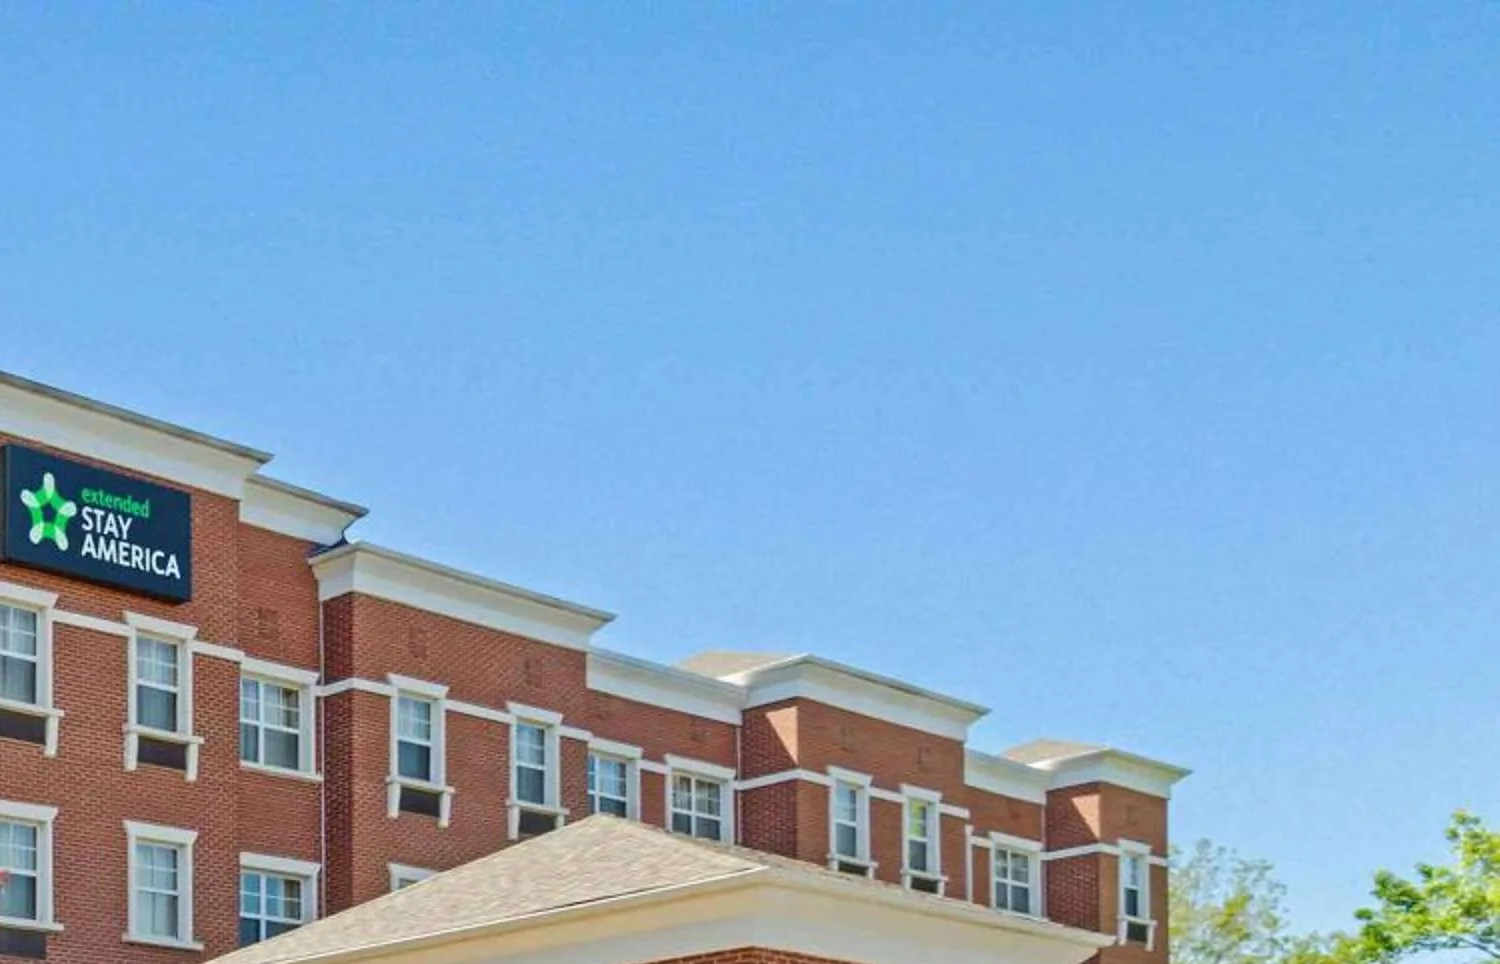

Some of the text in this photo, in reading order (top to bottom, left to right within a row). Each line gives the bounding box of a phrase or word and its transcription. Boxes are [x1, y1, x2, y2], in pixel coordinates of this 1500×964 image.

[81, 487, 150, 518] extended
[81, 506, 132, 540] STAY
[81, 533, 181, 580] AMERICA
